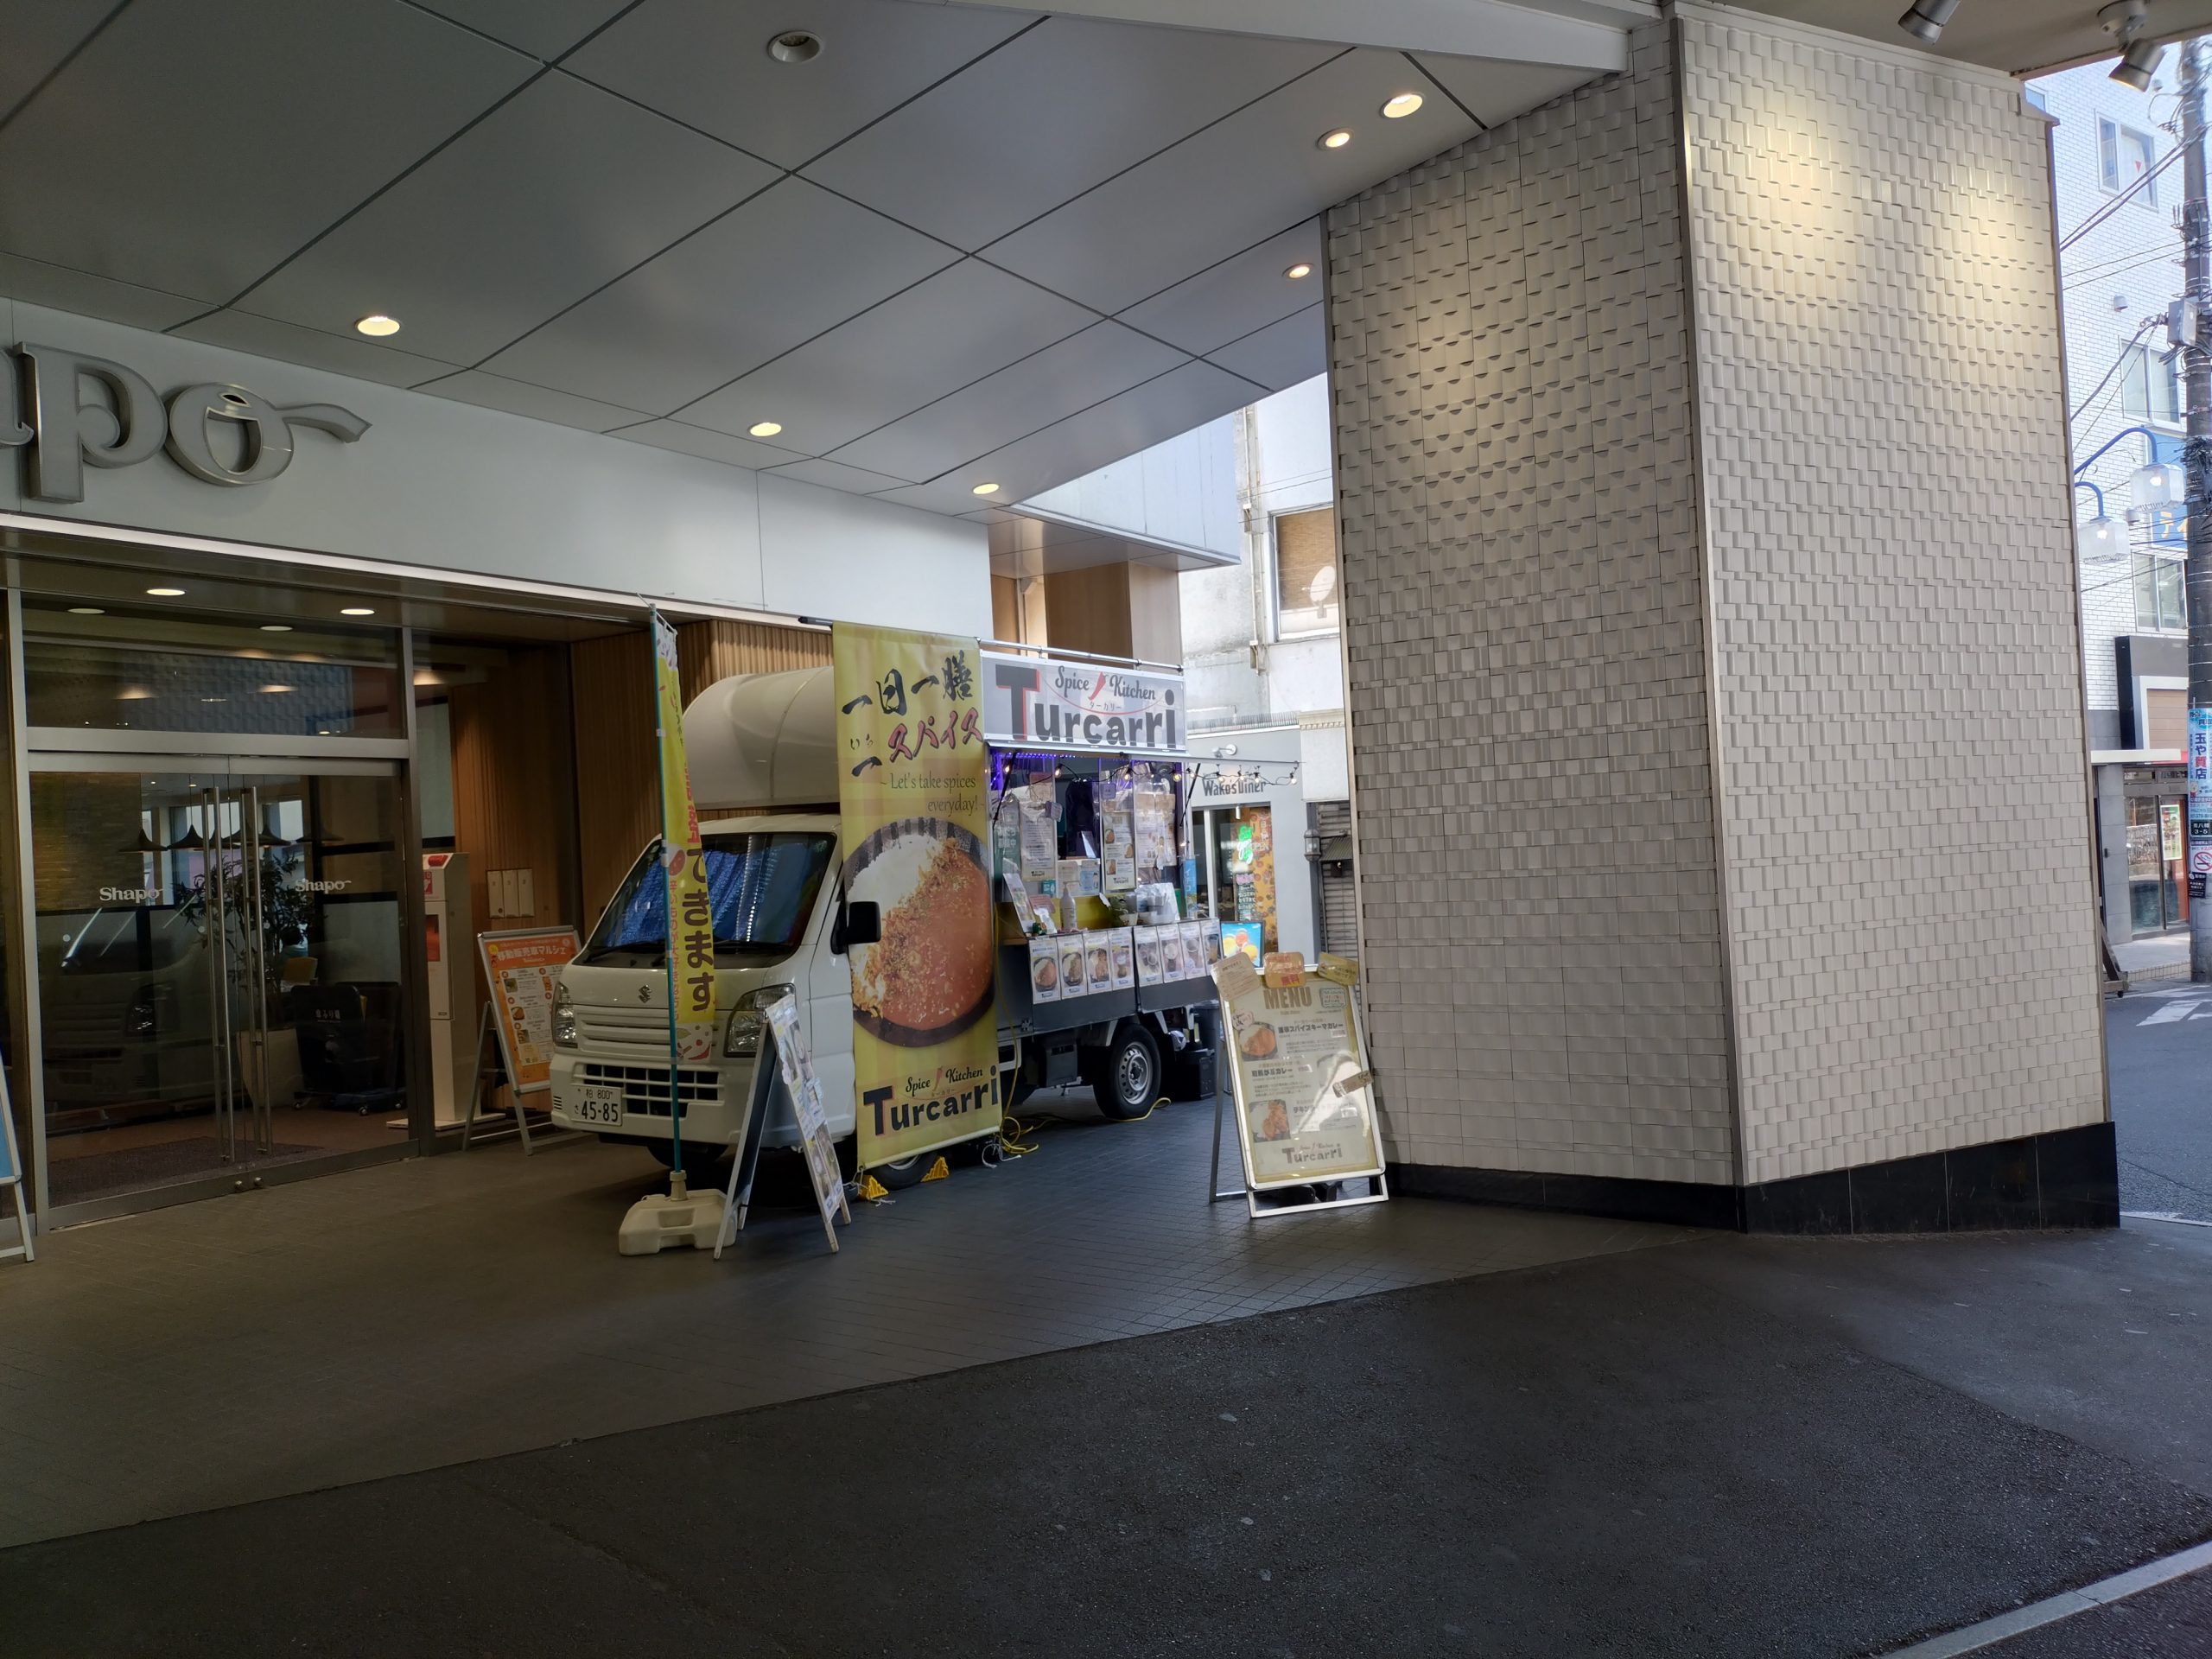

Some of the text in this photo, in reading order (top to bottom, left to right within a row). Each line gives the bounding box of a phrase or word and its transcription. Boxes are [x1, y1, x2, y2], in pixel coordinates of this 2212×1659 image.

[1055, 665, 1156, 701] Spice Kitchen
[995, 664, 1177, 749] Turcarri
[1089, 701, 1122, 710] ターカリー
[2196, 733, 2207, 779] 玉や質店
[890, 771, 976, 793] Let's take spices
[927, 793, 978, 817] everyday!
[99, 887, 164, 904] Shapo
[295, 878, 352, 894] Shapo
[1263, 986, 1313, 1010] MENU
[906, 1067, 983, 1097] Spice Kitchen
[597, 1089, 610, 1099] 800
[863, 1065, 999, 1136] Turcarri
[582, 1100, 619, 1122] 45-85
[1281, 1143, 1343, 1164] Turcarri
